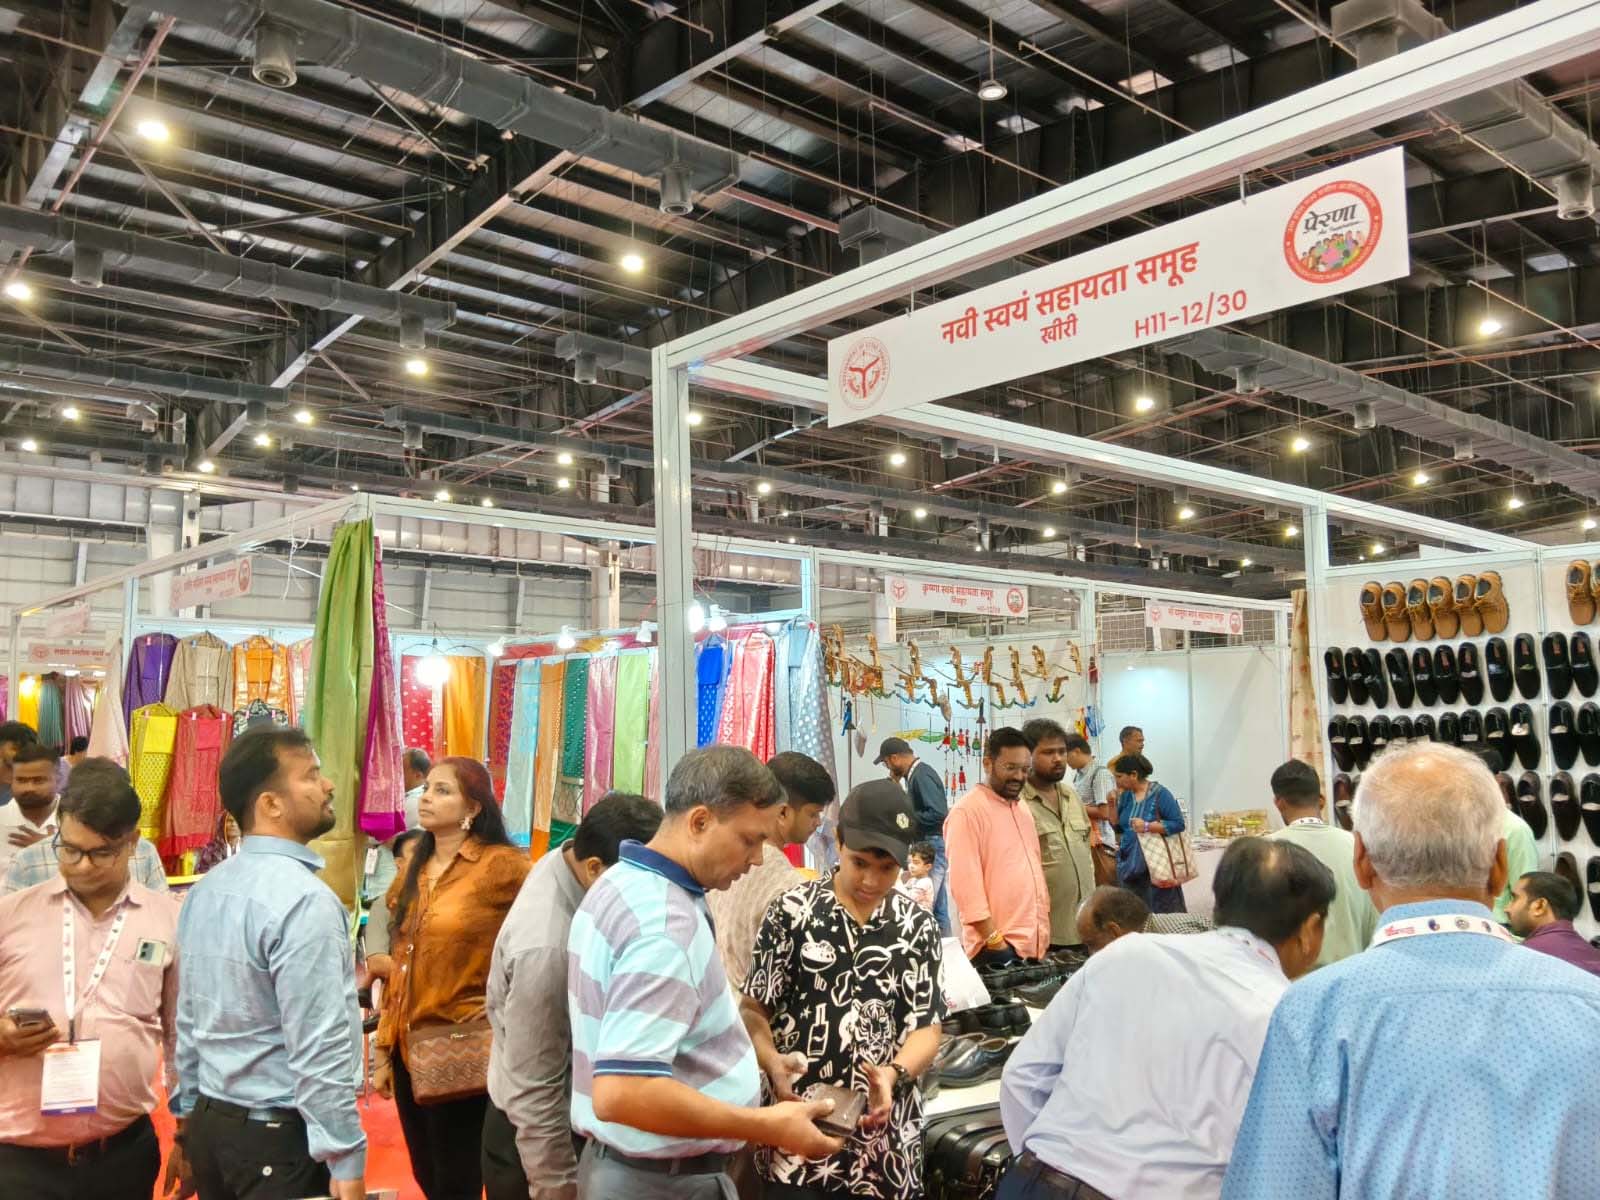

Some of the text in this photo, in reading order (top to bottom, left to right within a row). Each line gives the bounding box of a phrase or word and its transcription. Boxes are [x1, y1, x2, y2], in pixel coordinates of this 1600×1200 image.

[941, 241, 1200, 344] नवी स्वयं सहायता समूह
[1134, 289, 1248, 338] H11-12/30
[1040, 313, 1078, 344] खीरी
